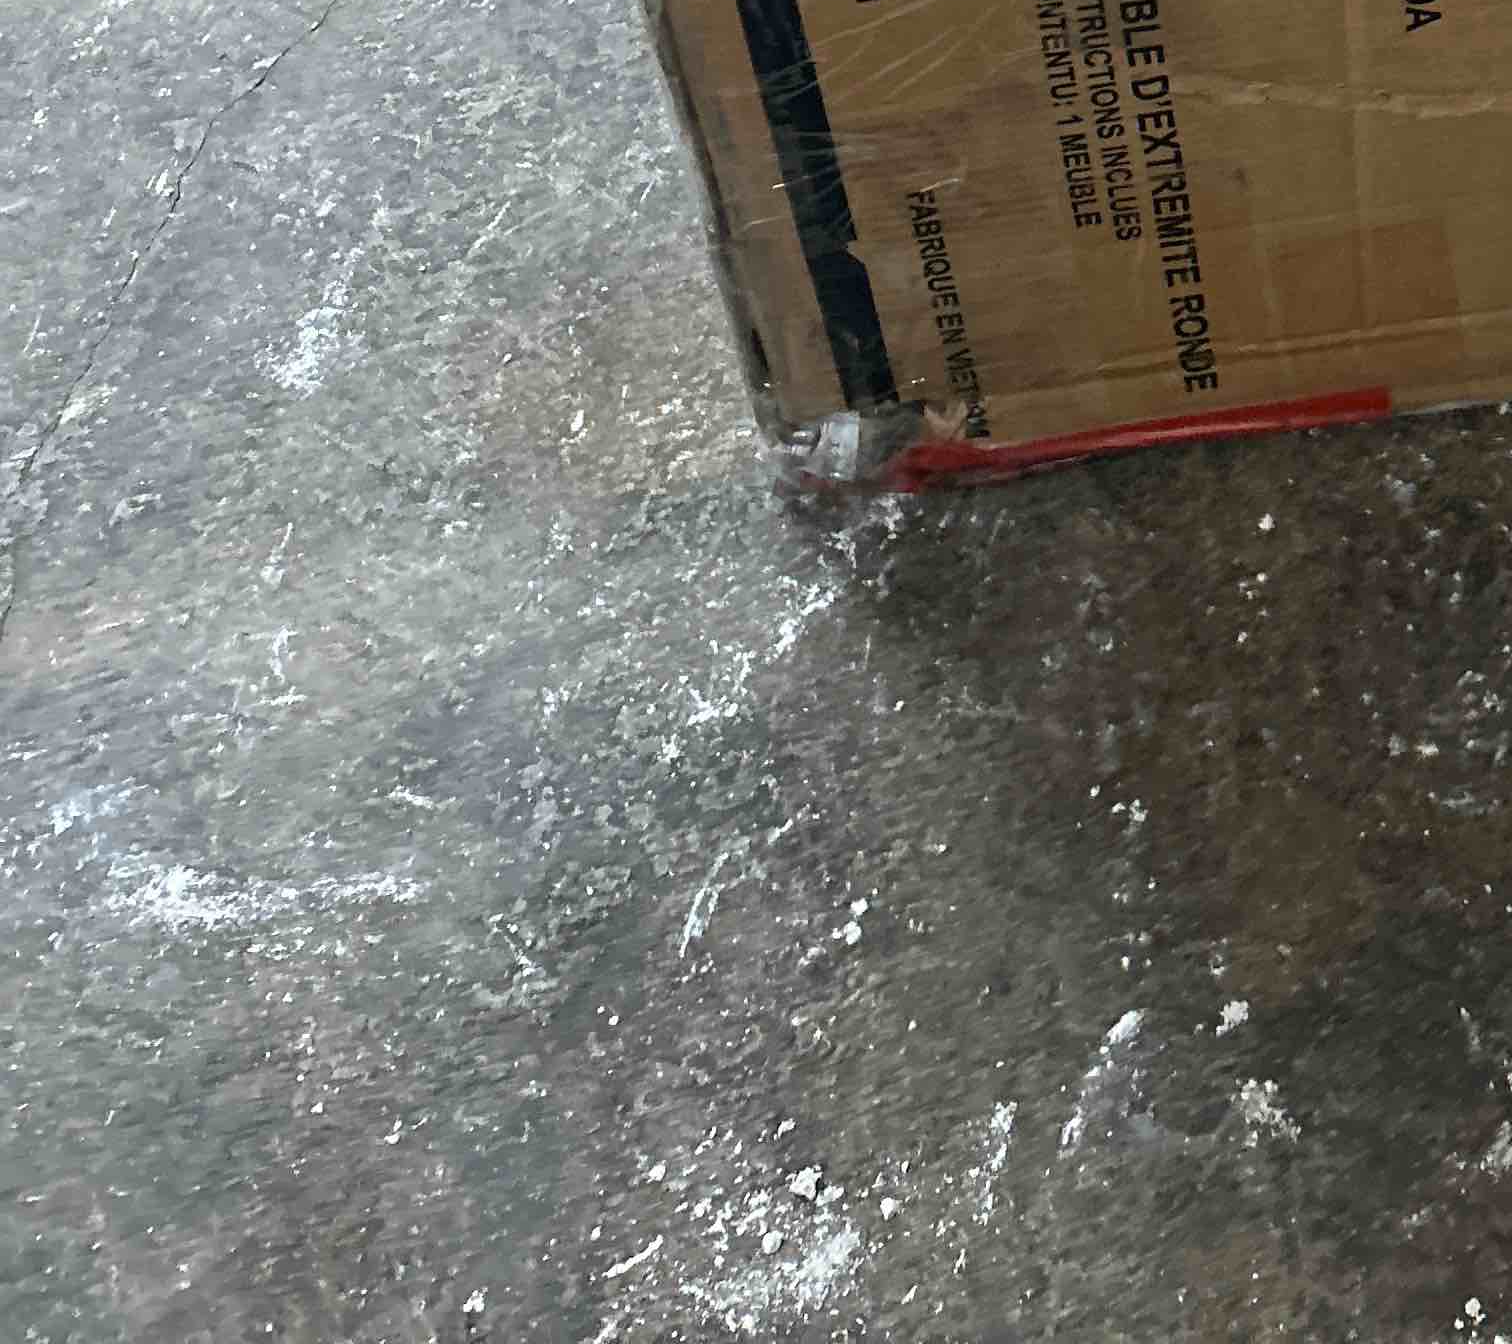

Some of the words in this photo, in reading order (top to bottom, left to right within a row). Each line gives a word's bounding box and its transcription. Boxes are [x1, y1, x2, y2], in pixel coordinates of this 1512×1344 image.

[1056, 114, 1084, 127] 1
[1059, 134, 1103, 228] MEUBLE
[1101, 144, 1142, 241] INCLUES
[907, 190, 960, 309] FABRIQUE
[936, 312, 966, 345] EN
[1131, 75, 1202, 288] D'EXTREMITE
[1170, 294, 1218, 393] RONDE
